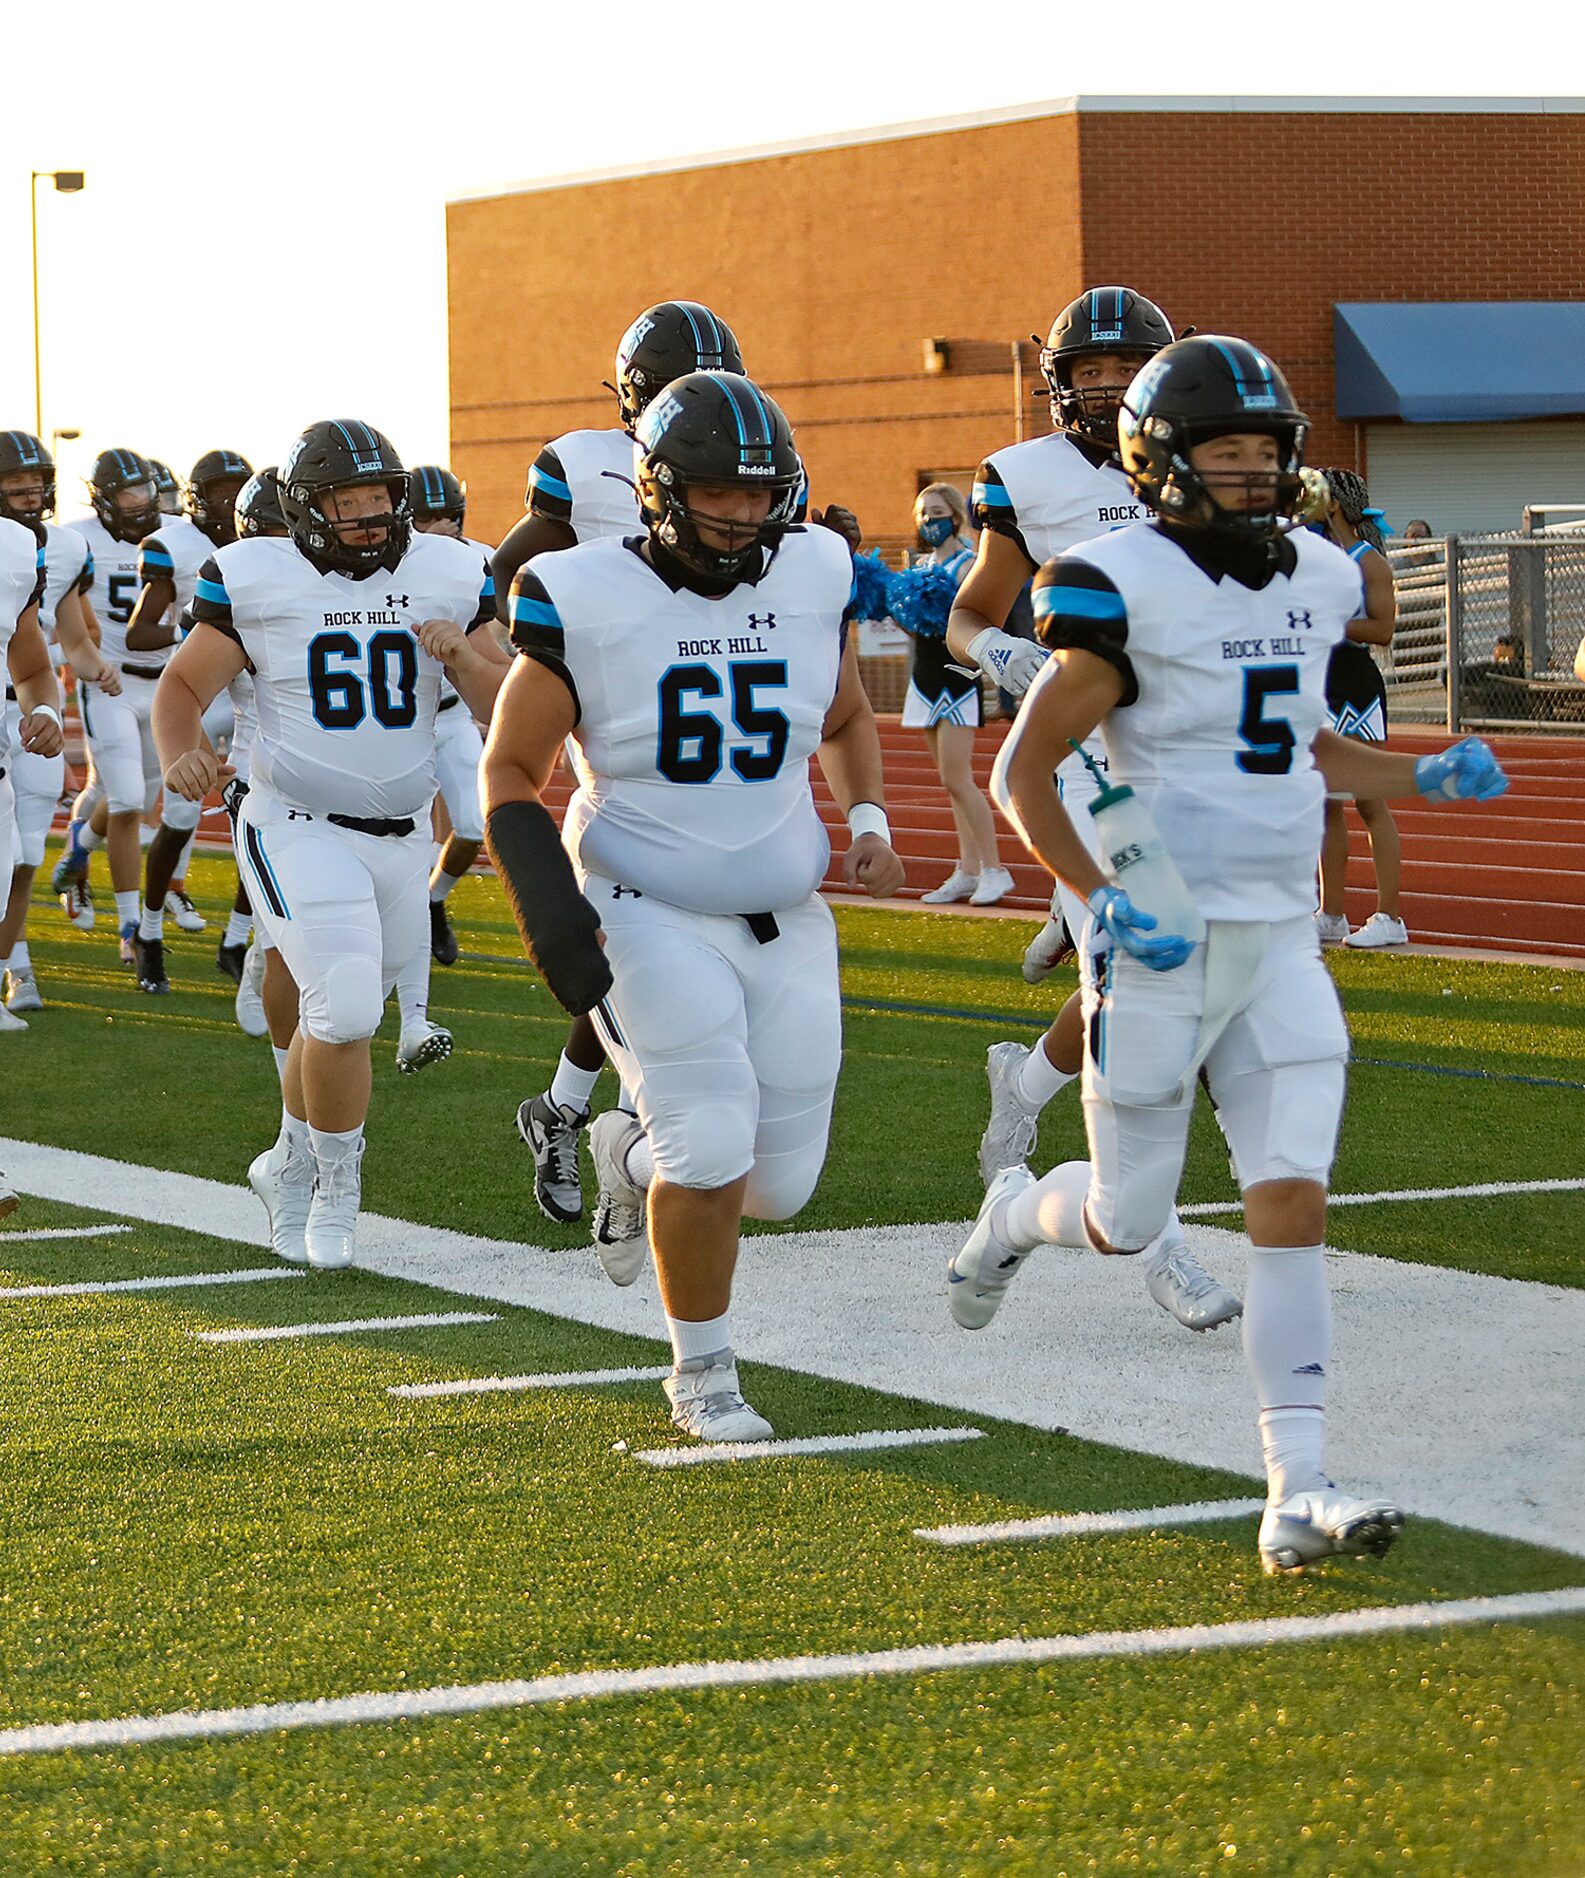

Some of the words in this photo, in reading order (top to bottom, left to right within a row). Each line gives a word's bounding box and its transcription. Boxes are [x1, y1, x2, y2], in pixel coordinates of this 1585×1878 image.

[738, 465, 776, 476] Riddell
[1097, 505, 1141, 522] ROCK
[117, 563, 140, 571] ROCK
[323, 611, 362, 627] ROCK
[367, 611, 401, 625] HILL
[677, 638, 723, 657] ROCK
[727, 637, 768, 654] HILL
[1221, 639, 1266, 659] ROCK
[1269, 637, 1306, 657] HILL
[307, 629, 419, 731] 60
[655, 659, 791, 784] 65
[1234, 662, 1301, 775] 5
